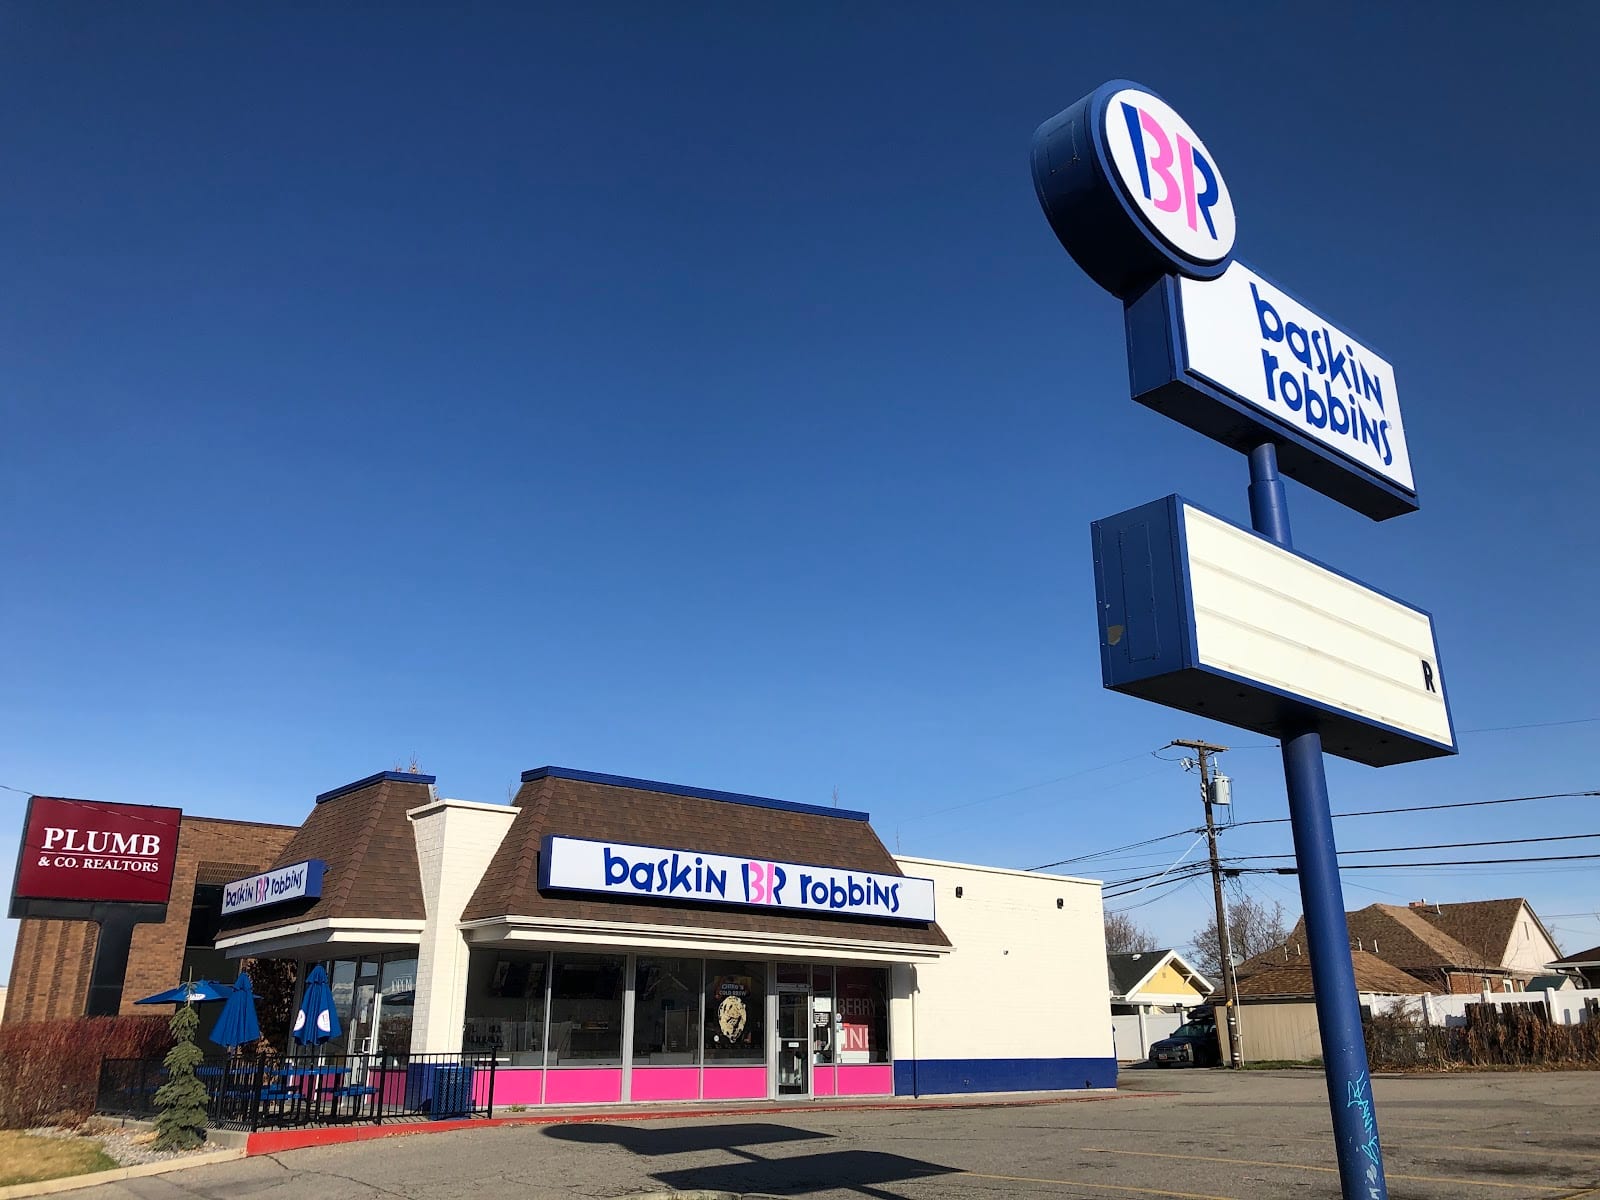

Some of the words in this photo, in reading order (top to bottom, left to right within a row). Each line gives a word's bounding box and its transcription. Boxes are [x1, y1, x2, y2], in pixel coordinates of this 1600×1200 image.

[1119, 101, 1219, 240] BR
[1249, 282, 1385, 415] baskin
[1261, 348, 1392, 466] robbins
[1421, 659, 1436, 693] R
[38, 856, 50, 867] &
[54, 857, 79, 868] CO.
[83, 859, 159, 873] REALTORS
[41, 827, 160, 856] PLUMB
[226, 883, 253, 907] baskin
[271, 869, 304, 896] robbins
[603, 847, 726, 899] baskin
[741, 861, 787, 905] BR
[800, 873, 900, 913] robbins
